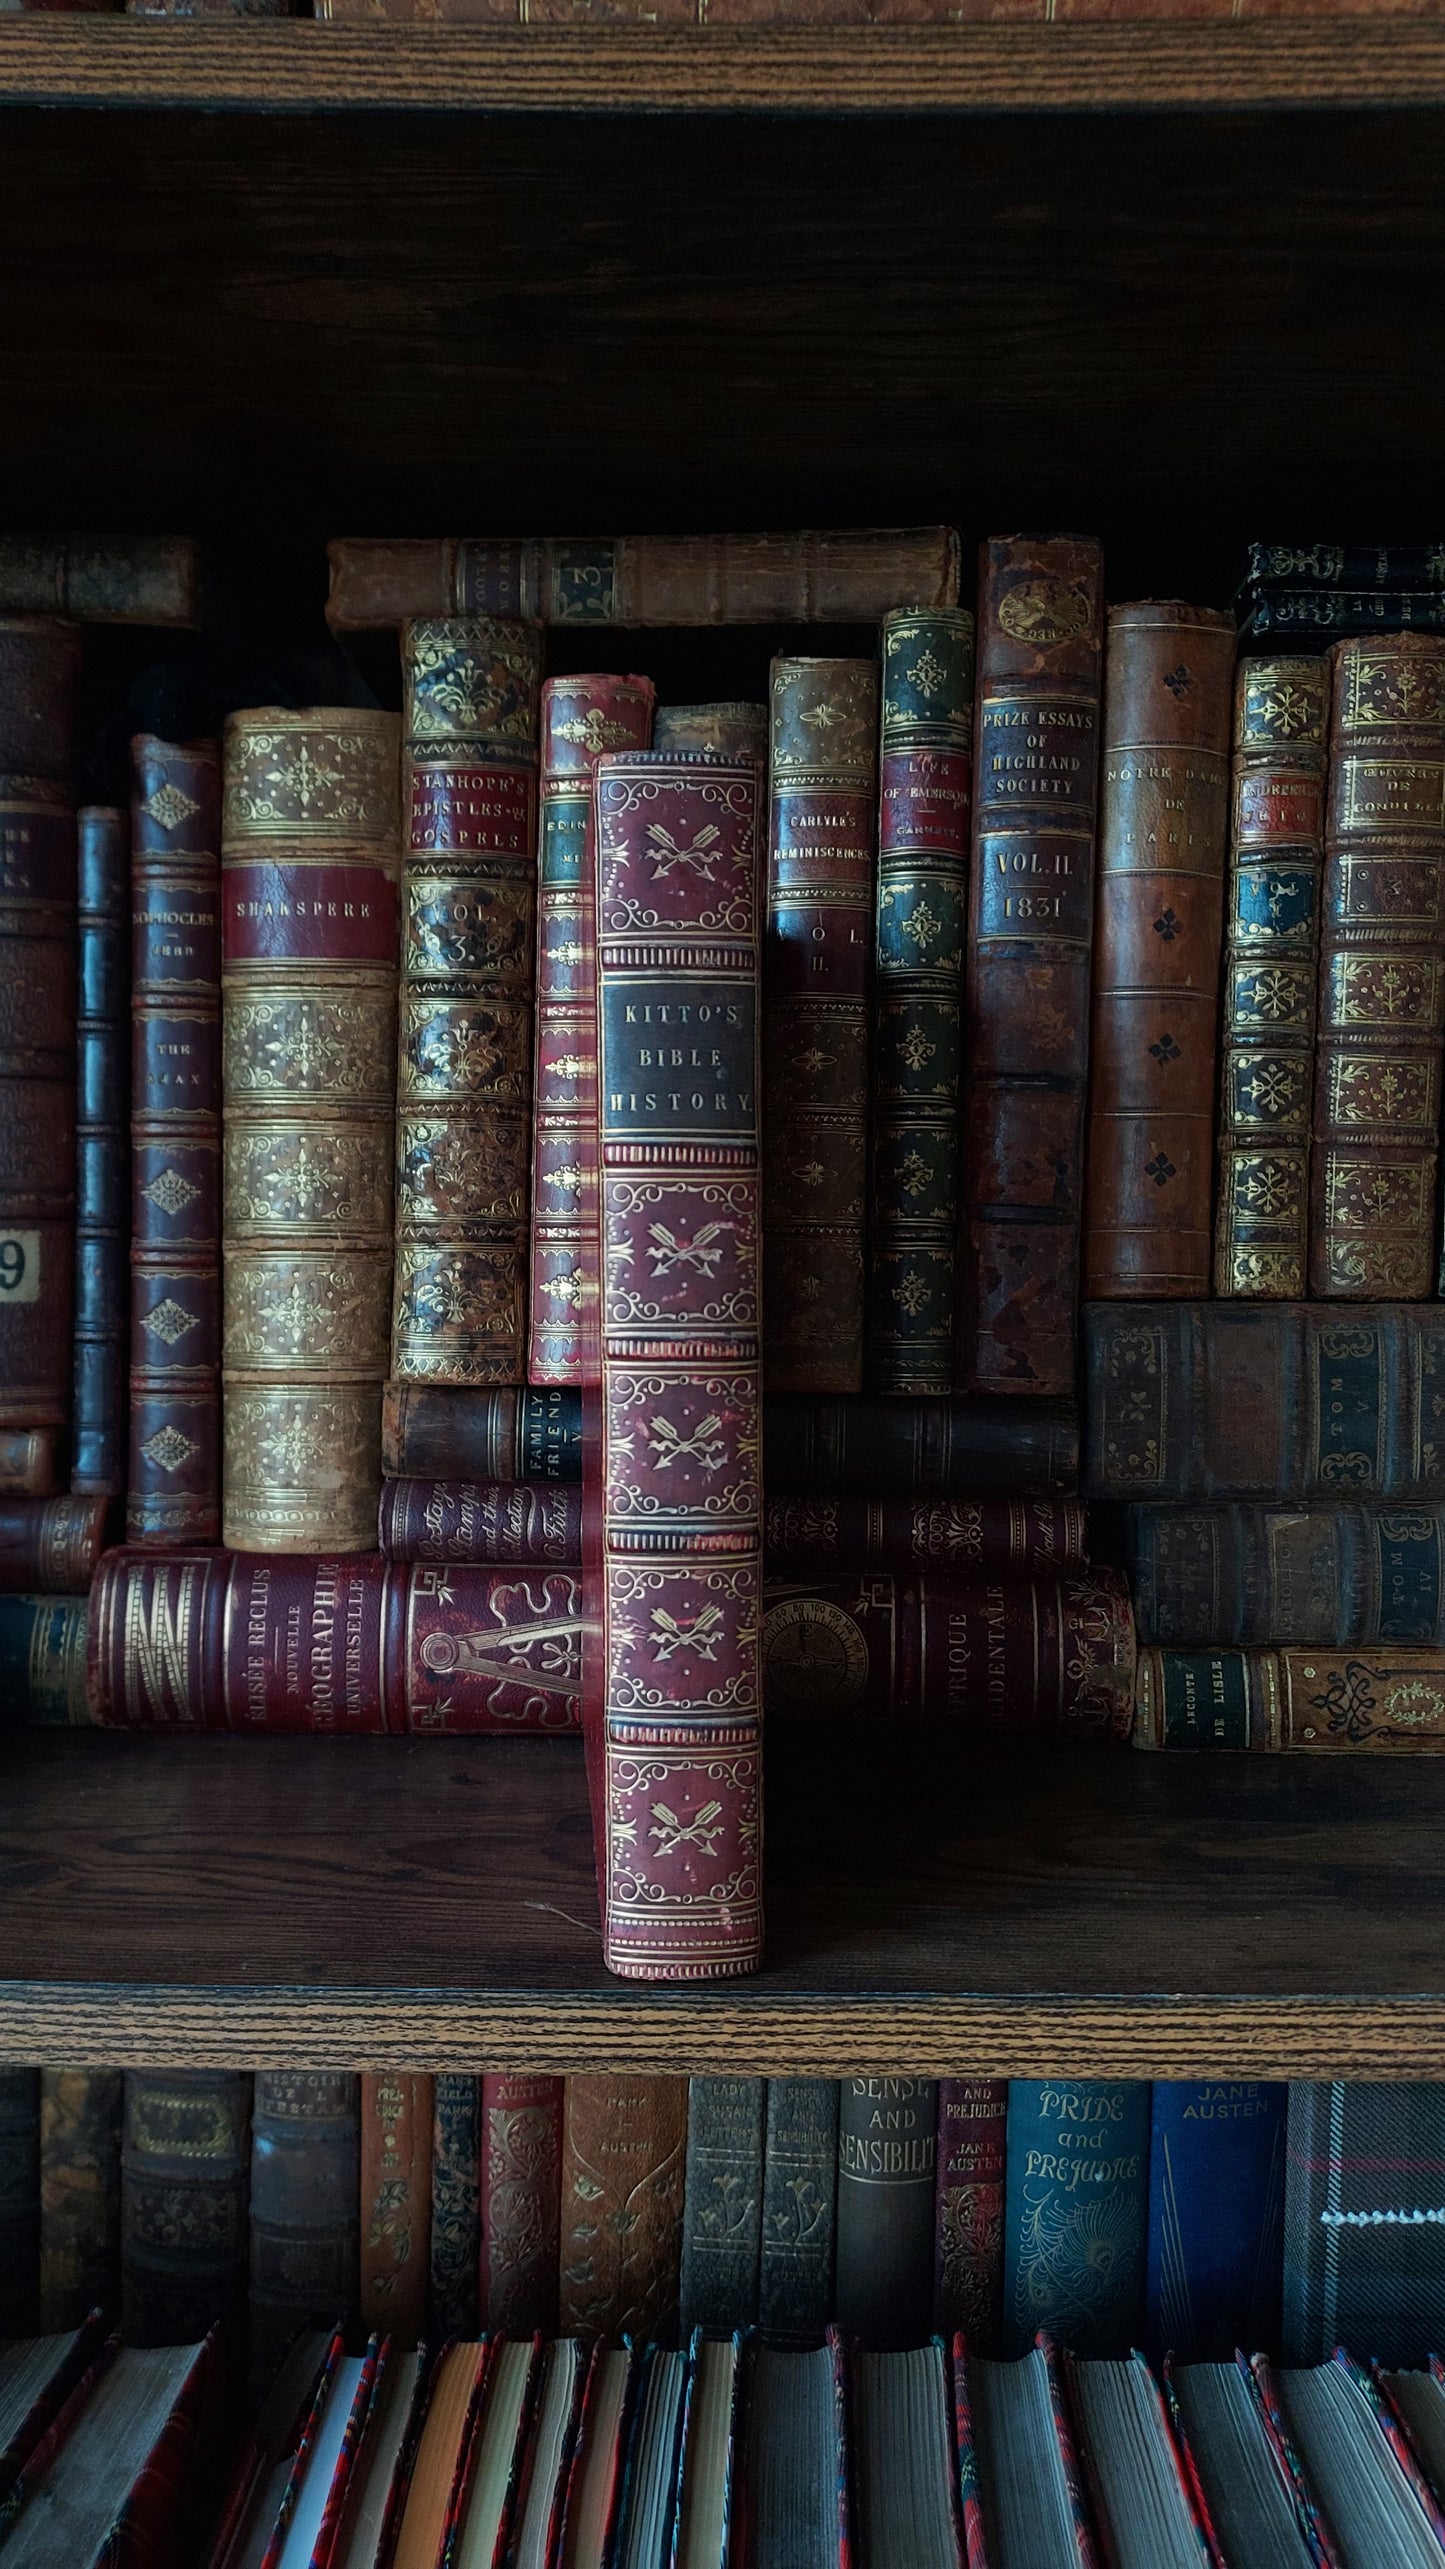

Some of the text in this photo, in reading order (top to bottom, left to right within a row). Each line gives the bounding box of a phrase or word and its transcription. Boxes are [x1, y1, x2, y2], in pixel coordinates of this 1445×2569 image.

[983, 711, 1094, 730] PRIZE ESSAYS
[1026, 734, 1048, 749] OF
[908, 760, 950, 776] LIFE
[992, 756, 1081, 772] HIGHLAND
[1107, 766, 1171, 782] NOTRE
[412, 775, 526, 796] STANHOPE'S
[883, 787, 901, 800] OF
[995, 778, 1074, 796] SOCIETY
[1386, 780, 1411, 792] DE
[412, 801, 502, 818] EPISTLES
[1165, 799, 1185, 811] DE
[790, 810, 857, 828] CARLYLE'S
[412, 830, 519, 849] GOSPELS
[1125, 832, 1211, 848] PARIS
[773, 847, 871, 861] REMINISCENCES
[235, 901, 371, 918] SHAKSPERE
[430, 906, 498, 924] VOL.
[1003, 896, 1062, 919] 1831
[132, 912, 215, 926] SOPHOCLES
[624, 1004, 738, 1023] KITTO'S
[156, 1044, 191, 1055] THE
[639, 1049, 722, 1067] BIBLE
[147, 1073, 201, 1085] AJAX
[610, 1092, 753, 1113] HISTORY.
[1331, 1377, 1344, 1437] TOM
[530, 1395, 544, 1470] FAMILY
[547, 1391, 562, 1476] FRIEND
[480, 1485, 500, 1524] their
[418, 1482, 455, 1560] Postage
[447, 1483, 480, 1561] Stamps
[540, 1488, 569, 1544] Firth
[1392, 1551, 1405, 1606] TOM
[241, 1568, 272, 1720] ÉLISÉE RECLUS
[286, 1605, 301, 1695] NOUVELLE
[304, 1563, 340, 1728] GÉOGRAPHIE
[345, 1579, 365, 1716] UNIVERSELLE
[1185, 1672, 1196, 1725] LECONTE
[1211, 1661, 1225, 1738] DE LISLE
[963, 2087, 992, 2100] AND
[1197, 2082, 1260, 2101] JANE
[946, 2101, 1006, 2120] PREJUDICE
[1038, 2089, 1125, 2123] PRIDE
[1182, 2099, 1269, 2120] AUSTEN
[868, 2109, 917, 2129] AND
[1057, 2127, 1109, 2149] and
[956, 2142, 996, 2156] JANE
[946, 2155, 1003, 2173] AUSTEN
[1024, 2149, 1142, 2193] PREJUDICE
